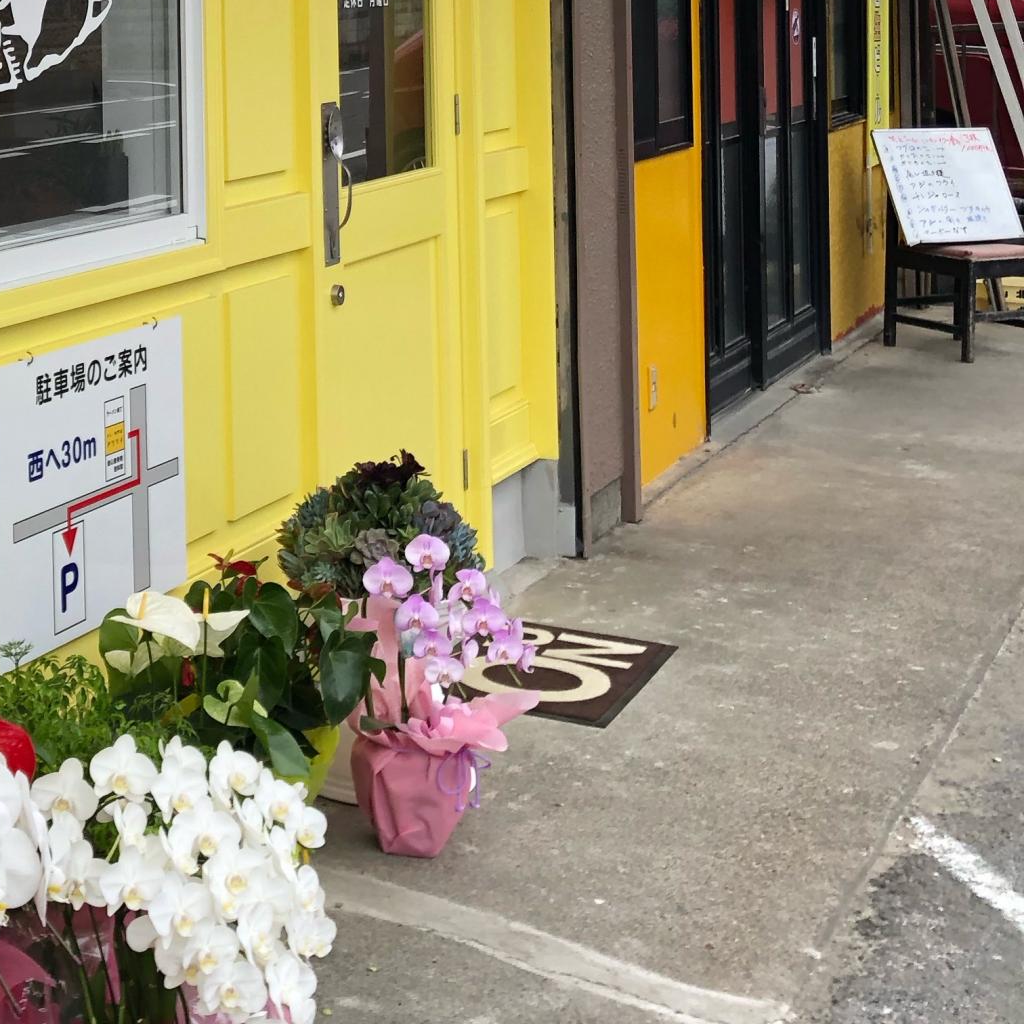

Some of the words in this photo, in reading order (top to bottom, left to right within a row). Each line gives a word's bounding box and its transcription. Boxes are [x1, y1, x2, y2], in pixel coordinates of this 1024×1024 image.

[35, 343, 148, 406] 駐車場のご案内
[27, 435, 97, 483] 西へ30m
[61, 562, 79, 613] P
